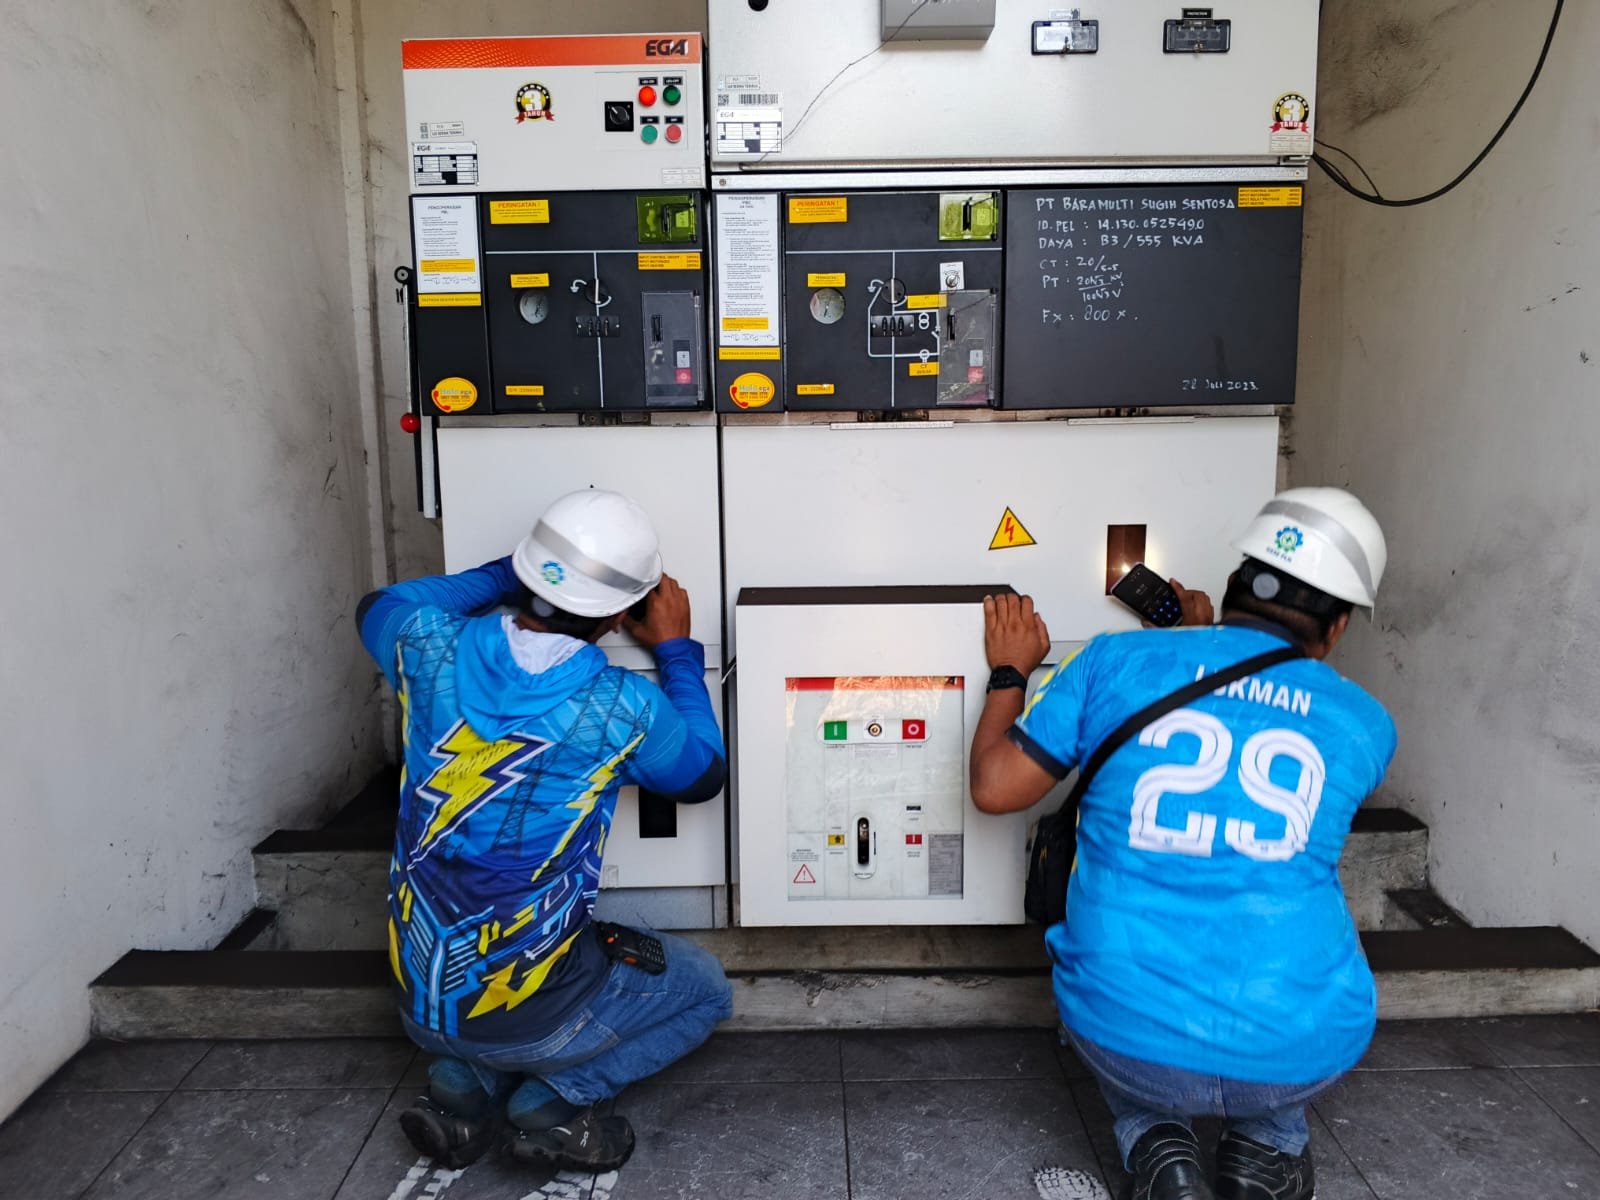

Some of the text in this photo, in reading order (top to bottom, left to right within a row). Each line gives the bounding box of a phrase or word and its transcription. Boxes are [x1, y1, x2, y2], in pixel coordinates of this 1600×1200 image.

[646, 39, 689, 57] EGA
[1035, 198, 1055, 212] PT
[1140, 198, 1177, 211] SUGIH
[1181, 198, 1236, 211] SENTOSA
[1038, 236, 1074, 250] DAYA
[1171, 234, 1204, 247] KVA
[1039, 258, 1057, 270] CT
[1042, 274, 1060, 289] PT
[1083, 304, 1111, 322] 800
[1128, 708, 1326, 862] 29
